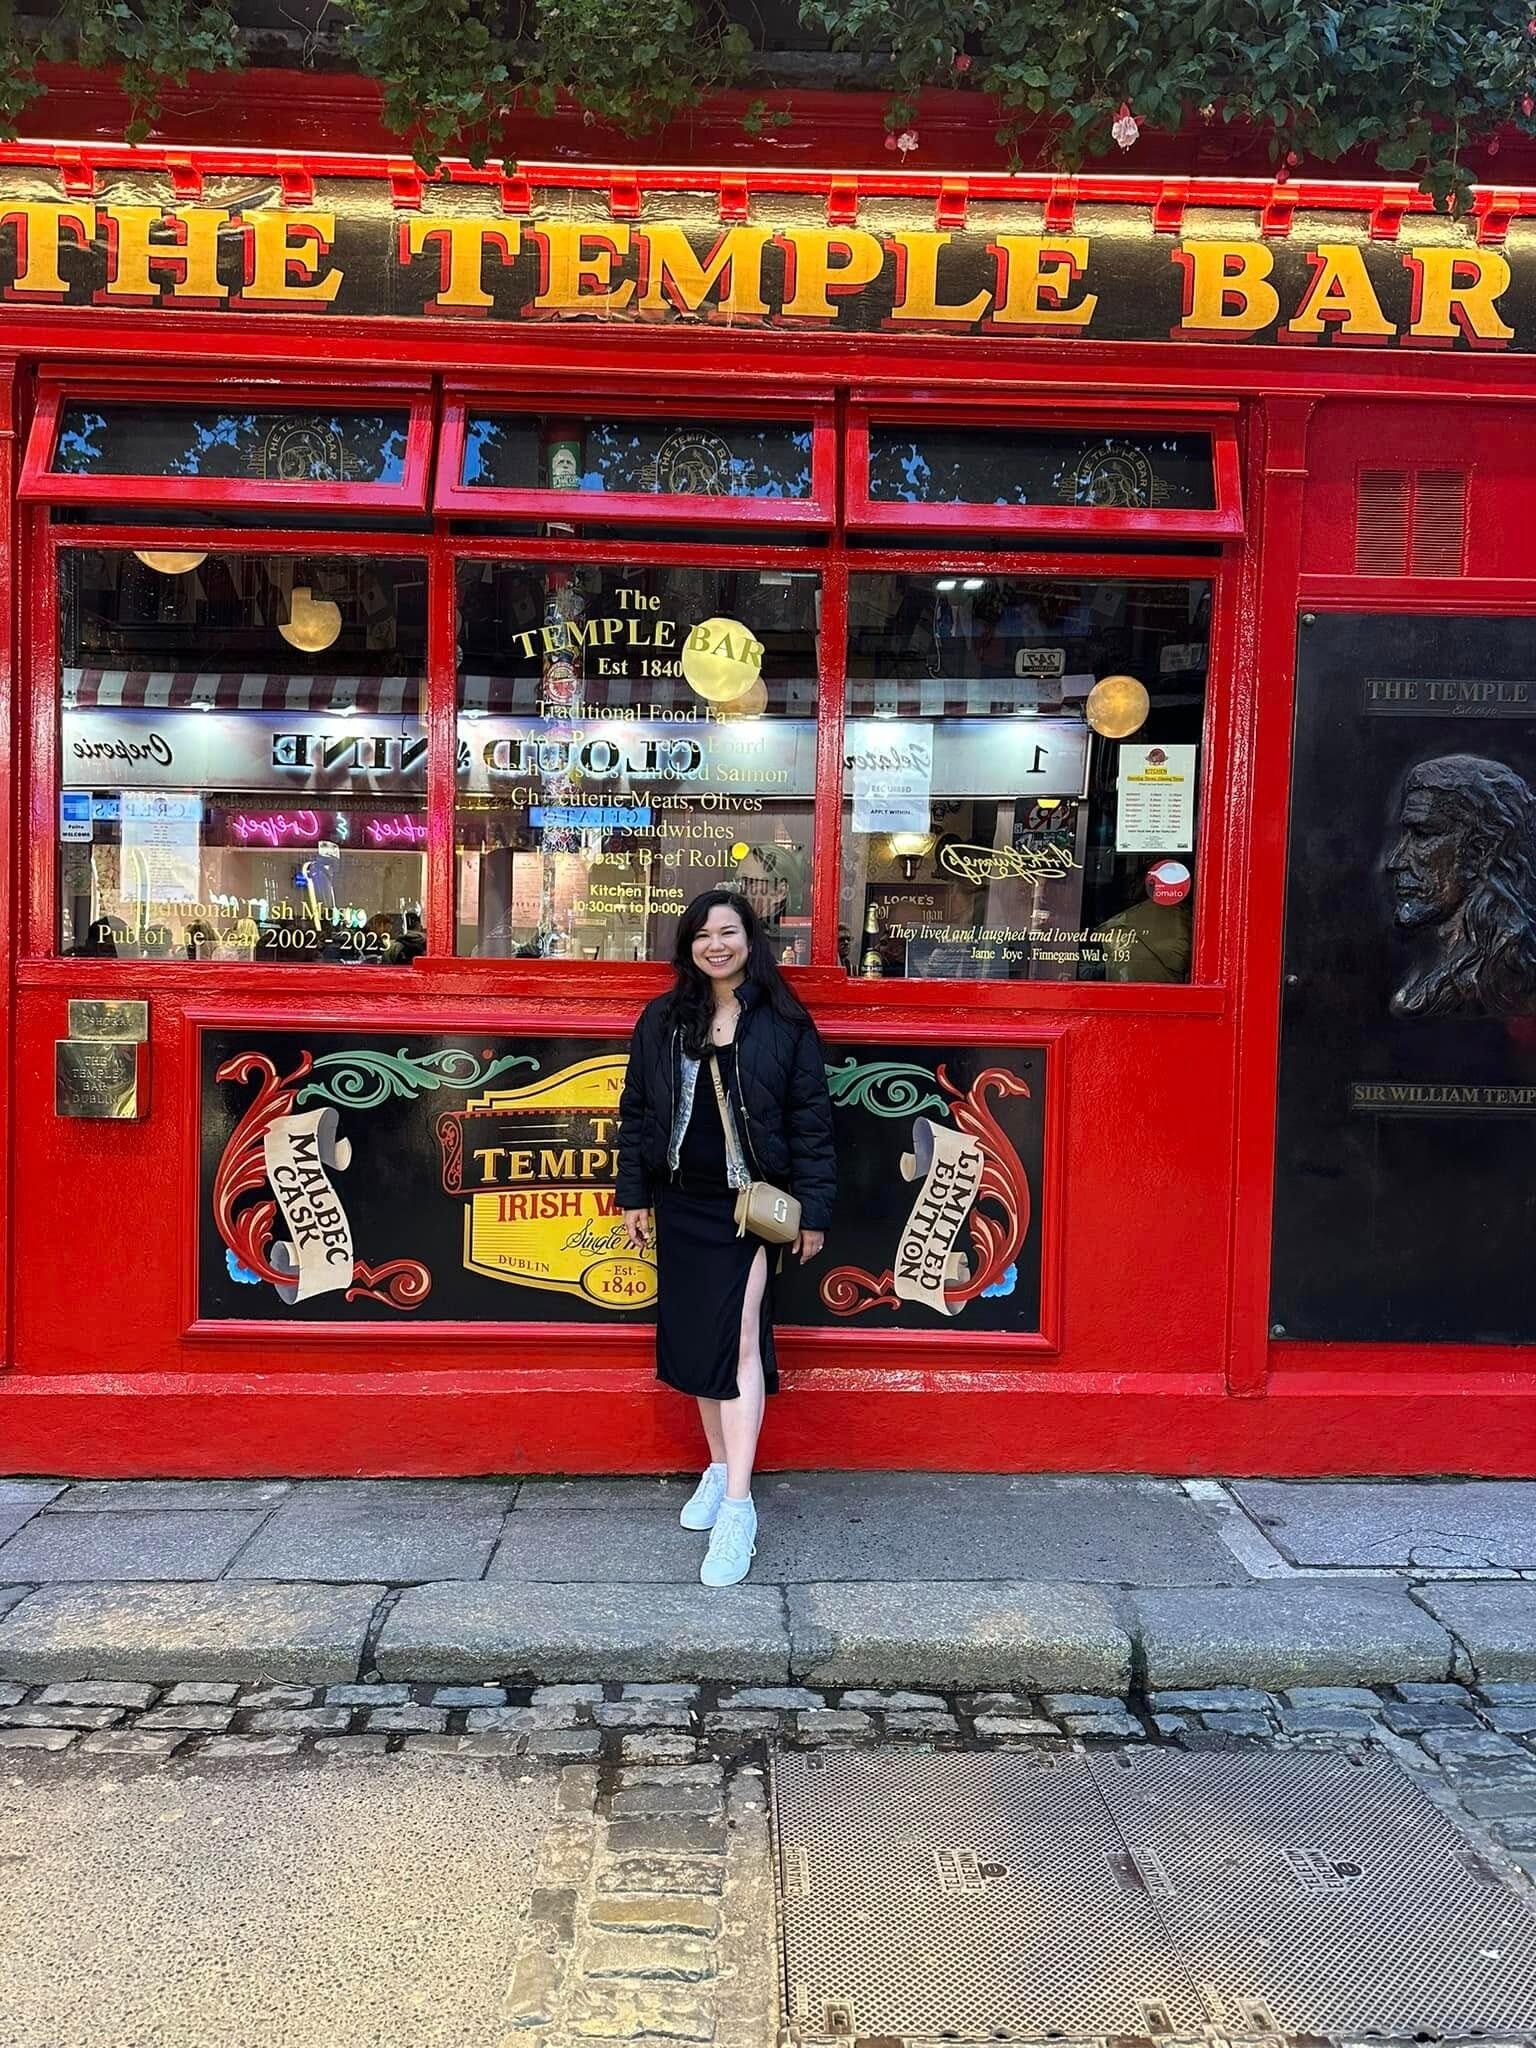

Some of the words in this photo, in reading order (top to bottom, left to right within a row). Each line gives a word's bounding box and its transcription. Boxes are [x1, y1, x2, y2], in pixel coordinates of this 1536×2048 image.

[0, 200, 344, 311] THE
[401, 219, 1098, 332] TEMPLE
[1171, 239, 1515, 348] BAR
[267, 434, 282, 461] THE
[324, 433, 338, 461] BAR
[659, 447, 674, 476] THE
[670, 432, 719, 450] TEMPLE
[715, 447, 730, 476] BAR
[1134, 459, 1149, 488] BAR
[615, 588, 661, 611] The
[512, 618, 676, 660] TEMPLE
[687, 623, 767, 669] BAR
[598, 658, 628, 676] Est
[640, 658, 684, 678] 1840
[1367, 680, 1418, 700] THE
[1424, 682, 1529, 703] TEMPLE
[534, 699, 643, 724] Traditional
[649, 703, 698, 725] Food
[716, 763, 789, 786] Salmon
[511, 786, 625, 807] Chcuterie
[630, 790, 695, 813] Meats,
[699, 792, 764, 813] Olives
[620, 820, 735, 840] Sandwiches
[578, 848, 632, 867] Roast
[638, 849, 684, 868] Beef
[688, 850, 738, 869] Rolls
[590, 884, 642, 899] Kitchen
[645, 885, 684, 899] Times
[129, 899, 239, 919] Tditional
[629, 902, 644, 913] to
[646, 902, 691, 917] 10:00p
[98, 925, 138, 946] Pub
[144, 925, 167, 946] of
[210, 927, 259, 948] Year
[265, 929, 318, 950] 2002
[340, 931, 392, 952] 2023
[920, 925, 949, 942] lived
[950, 925, 976, 943] and
[977, 926, 1026, 946] laughed
[1028, 926, 1052, 943] and
[1053, 926, 1087, 944] loved
[1089, 927, 1113, 945] and
[1032, 947, 1080, 964] Finnegans
[71, 1068, 120, 1079] TEMPLE
[83, 1055, 109, 1066] THE
[82, 1081, 108, 1091] BAR
[1354, 1085, 1385, 1100] SIR
[1389, 1086, 1479, 1104] WILLIAM
[1483, 1088, 1536, 1105] TEMP
[72, 1094, 120, 1105] DUBLIN
[473, 1147, 620, 1184] TEMP
[273, 1165, 320, 1250] CASK
[288, 1132, 348, 1265] MALBEC
[497, 1191, 583, 1223] IRISH
[899, 1159, 956, 1283] EDITION
[920, 1150, 980, 1291] LIMITED
[560, 1217, 622, 1256] Single
[498, 1253, 550, 1273] DUBLIN
[613, 1265, 637, 1277] Est.
[602, 1276, 647, 1297] 1840
[787, 1847, 803, 1895] CAVANAGH
[936, 1850, 961, 1891] TELECOM
[957, 1851, 982, 1890] EIREANN
[1134, 1848, 1169, 1895] CAVANAGH
[1284, 1849, 1323, 1890] TELECOM
[1305, 1850, 1345, 1889] EIREANN
